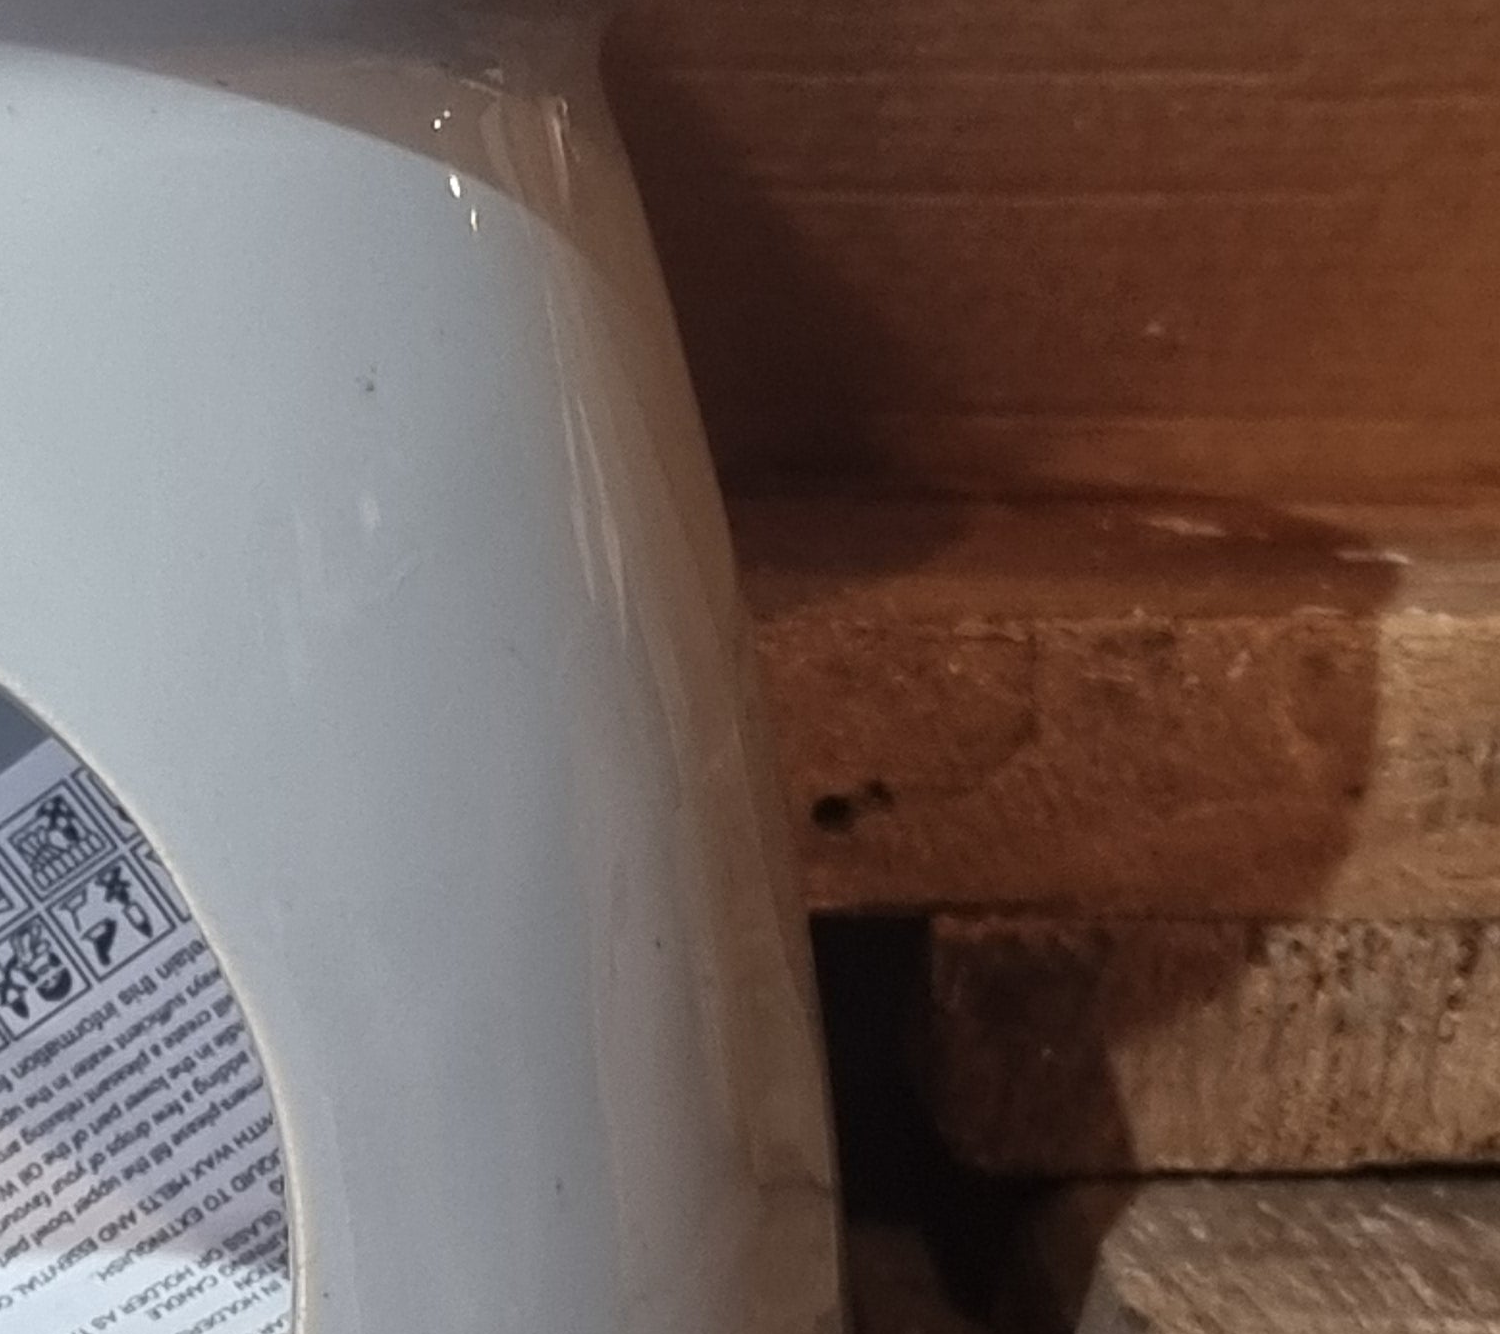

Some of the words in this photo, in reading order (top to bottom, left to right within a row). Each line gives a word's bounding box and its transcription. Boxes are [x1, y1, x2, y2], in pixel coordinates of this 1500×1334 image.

[154, 938, 208, 981] etain
[117, 974, 159, 1007] this
[9, 1000, 121, 1080] information
[113, 992, 188, 1051] sufficient
[161, 1009, 213, 1050] create
[70, 1043, 116, 1080] water
[166, 1055, 198, 1081] the
[193, 1042, 217, 1061] in
[51, 1072, 73, 1092] in
[83, 1048, 151, 1105] pleasant
[191, 1049, 251, 1097] adding
[23, 1085, 55, 1110] the
[123, 1074, 172, 1112] lower
[19, 1097, 86, 1146] relaxing
[87, 1101, 124, 1136] part
[151, 1099, 186, 1126] few
[170, 1100, 223, 1147] please
[41, 1140, 73, 1167] the
[70, 1128, 90, 1153] of
[104, 1119, 152, 1158] drops
[17, 1161, 44, 1188] Oil
[51, 1159, 88, 1197] your
[87, 1151, 107, 1176] of
[120, 1155, 152, 1182] the
[188, 1143, 237, 1181] WAX
[73, 1175, 122, 1216] upper
[137, 1172, 192, 1216] MELTS
[202, 1187, 233, 1213] TO
[30, 1209, 76, 1248] bowl
[97, 1208, 138, 1244] AND
[220, 1208, 286, 1254] GLASS
[11, 1236, 100, 1296] ESSENTIAL
[196, 1246, 225, 1270] OR
[118, 1266, 195, 1315] HOLDER
[145, 1275, 219, 1321] CANDLE
[90, 1309, 118, 1331] AS
